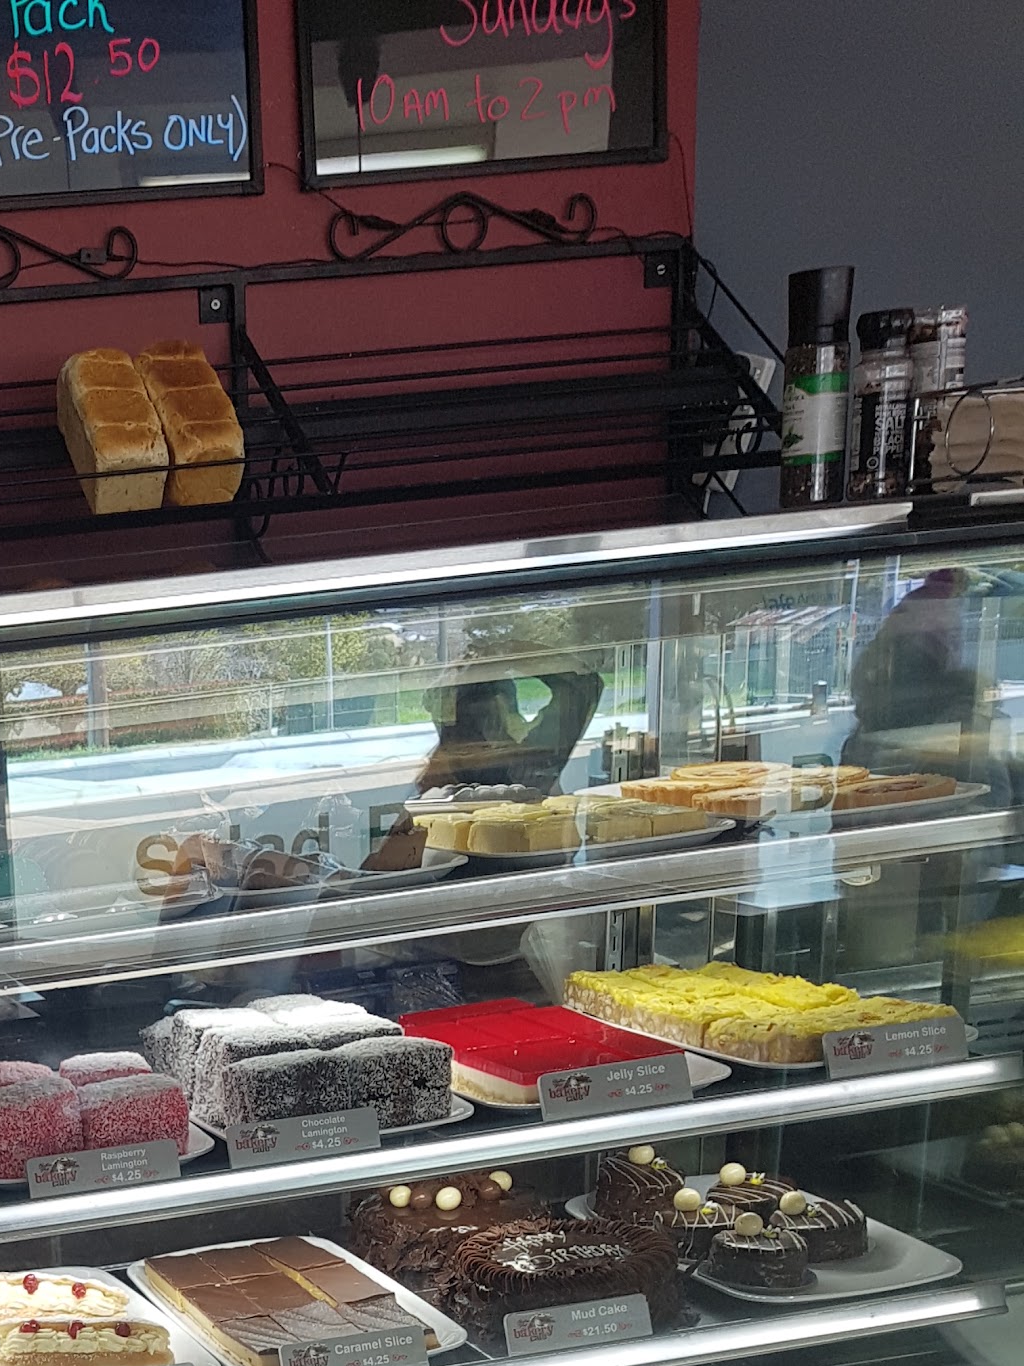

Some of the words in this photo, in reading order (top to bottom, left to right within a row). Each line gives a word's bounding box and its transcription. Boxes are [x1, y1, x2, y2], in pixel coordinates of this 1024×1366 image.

[467, 73, 510, 123] to
[519, 77, 547, 120] 2
[163, 94, 248, 161] ONLY)
[875, 415, 906, 432] SALT
[886, 1030, 919, 1041] Lemon
[921, 1026, 946, 1036] Slice
[905, 1045, 932, 1055] $4.25
[607, 1068, 634, 1082] Jelly
[637, 1064, 665, 1075] Slice
[625, 1084, 653, 1095] $4.25
[302, 1116, 345, 1128] Chocolate
[302, 1126, 347, 1138] Lamington
[312, 1137, 341, 1149] $4.25
[101, 1148, 146, 1161] Raspberry
[102, 1159, 147, 1171] Lamington
[112, 1170, 141, 1182] $4.25
[571, 1308, 596, 1320] Mud
[598, 1304, 628, 1315] Cake
[583, 1323, 617, 1336] $21.50
[335, 1340, 382, 1355] Caramel
[385, 1335, 413, 1347] Slice
[363, 1355, 390, 1366] $4.25
